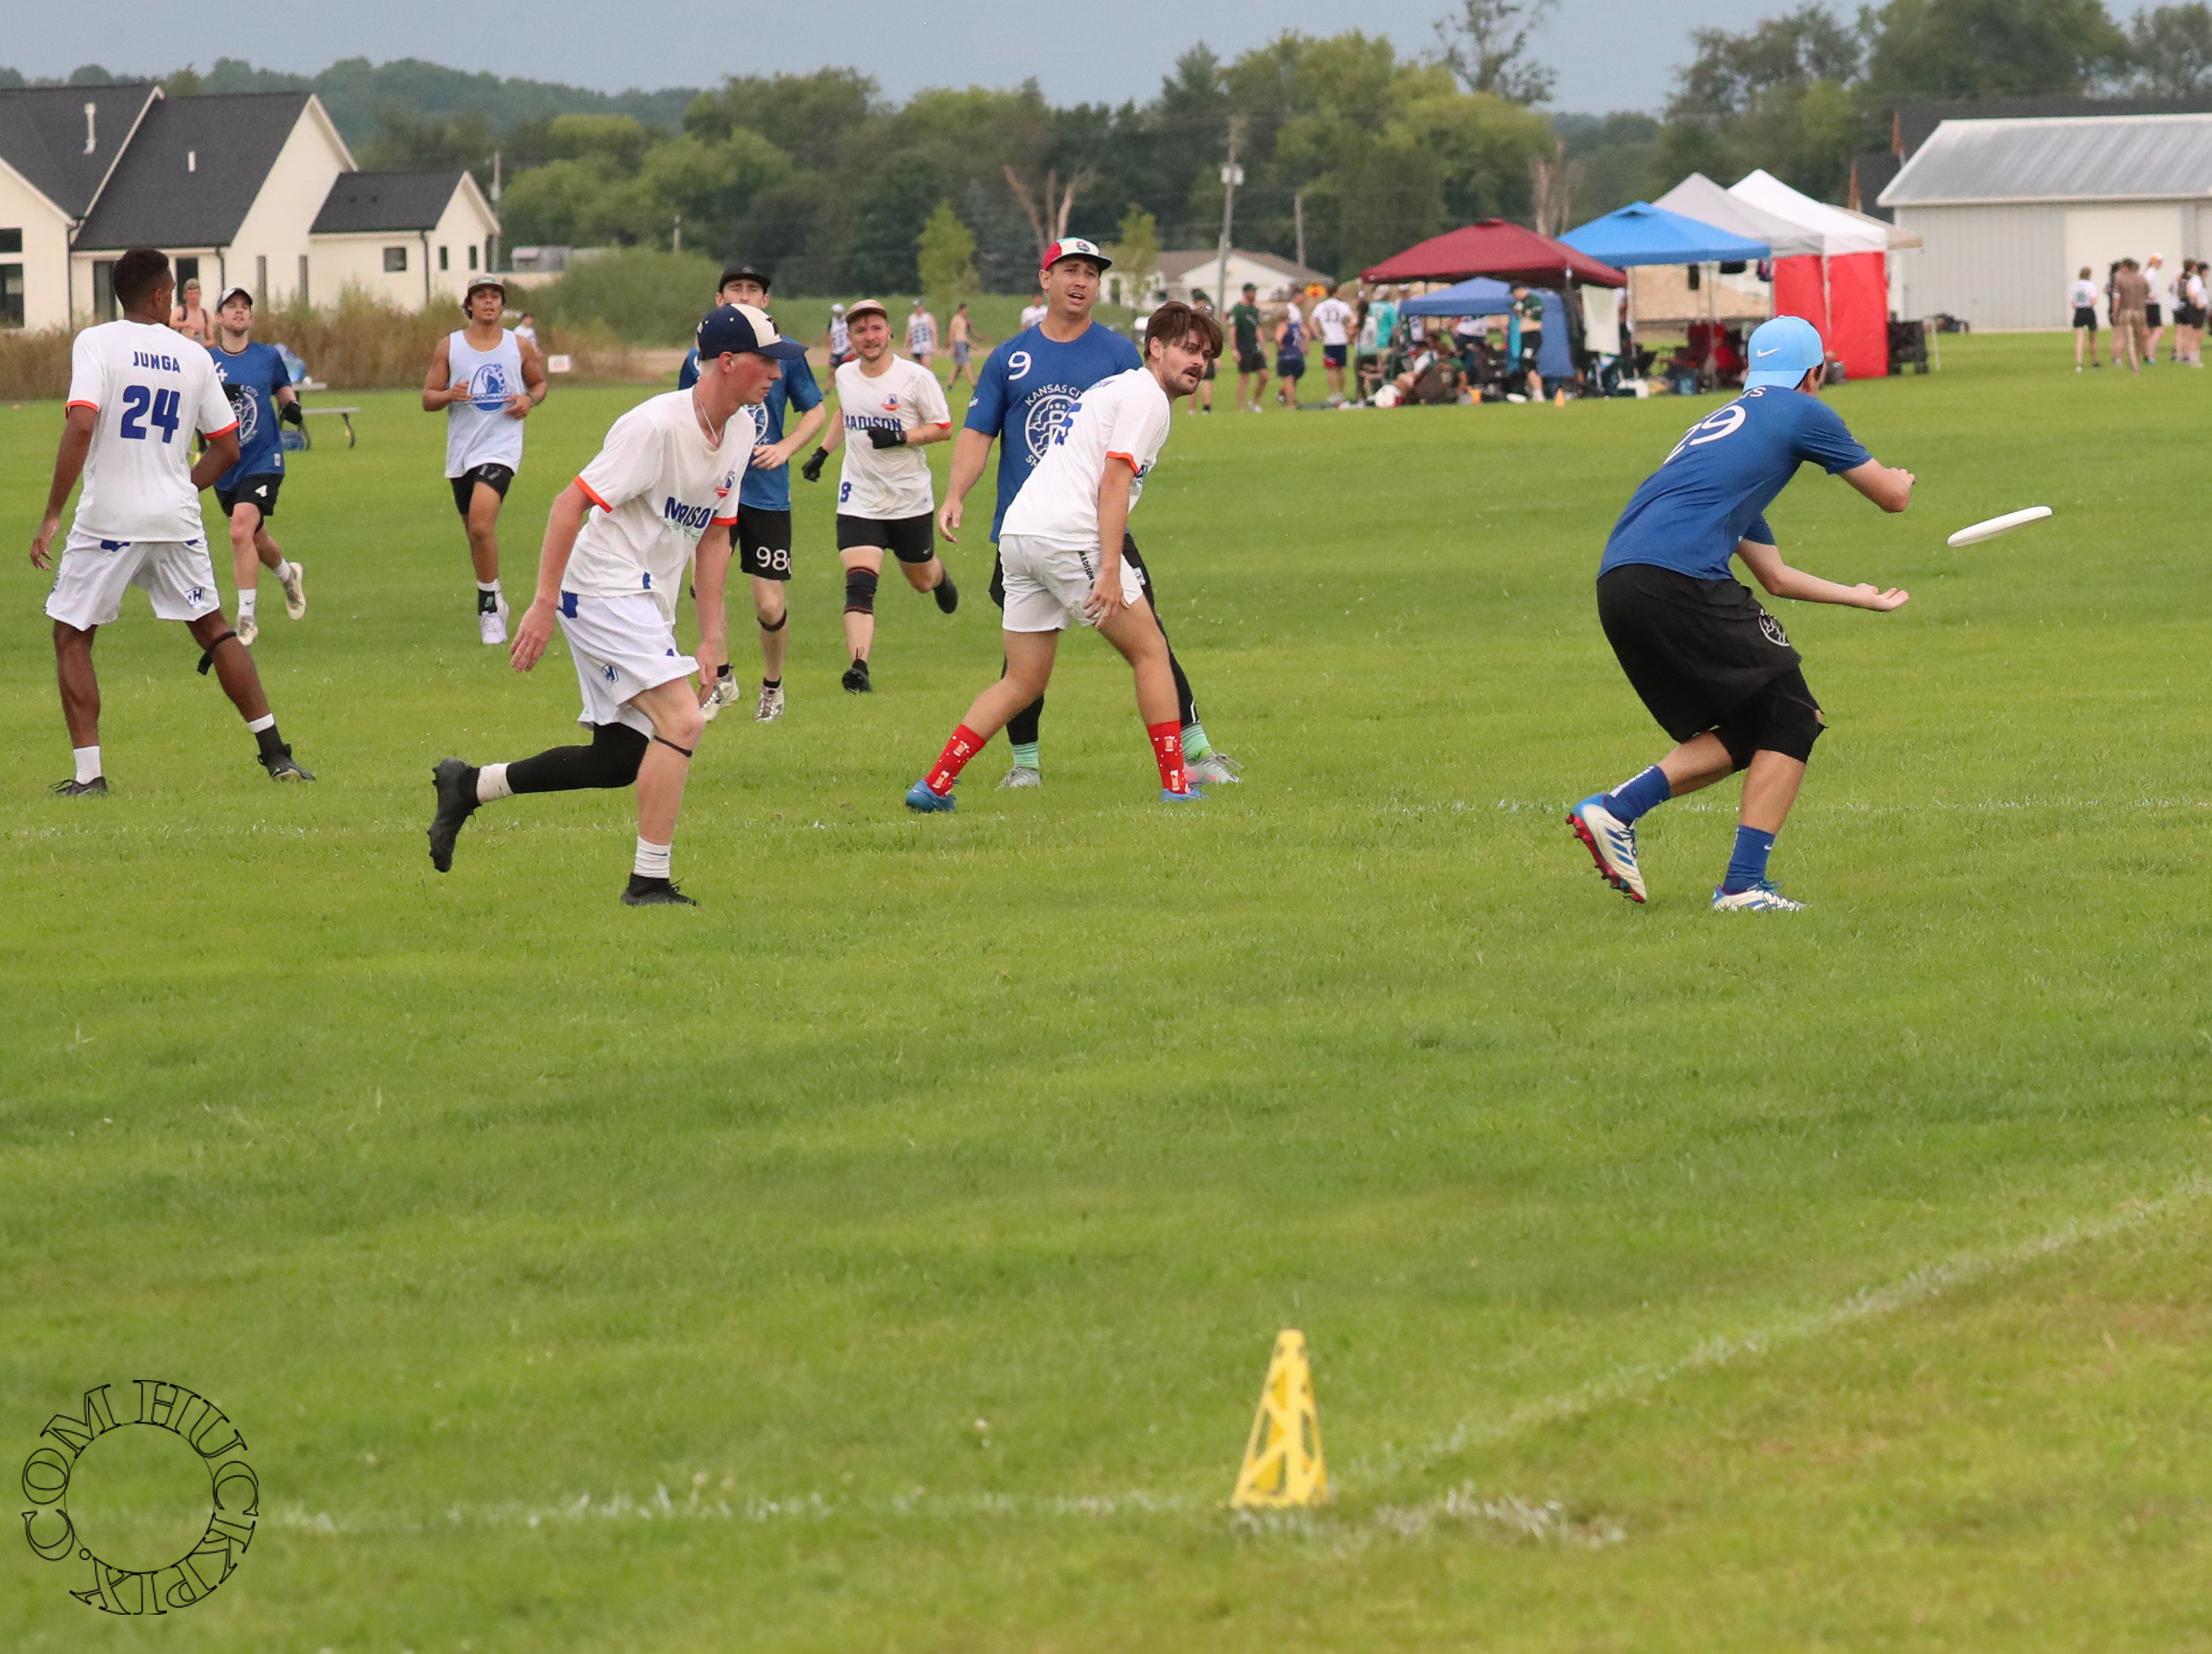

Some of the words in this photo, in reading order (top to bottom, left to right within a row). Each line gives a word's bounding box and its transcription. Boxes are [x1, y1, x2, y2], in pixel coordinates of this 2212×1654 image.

[133, 350, 180, 373] JUNGA
[1008, 350, 1032, 381] 9
[1024, 384, 1067, 407] KANSAS
[120, 385, 181, 444] 24
[479, 464, 502, 480] 17
[254, 484, 268, 498] 4
[756, 546, 788, 571] 98
[1078, 551, 1096, 581] MADISON
